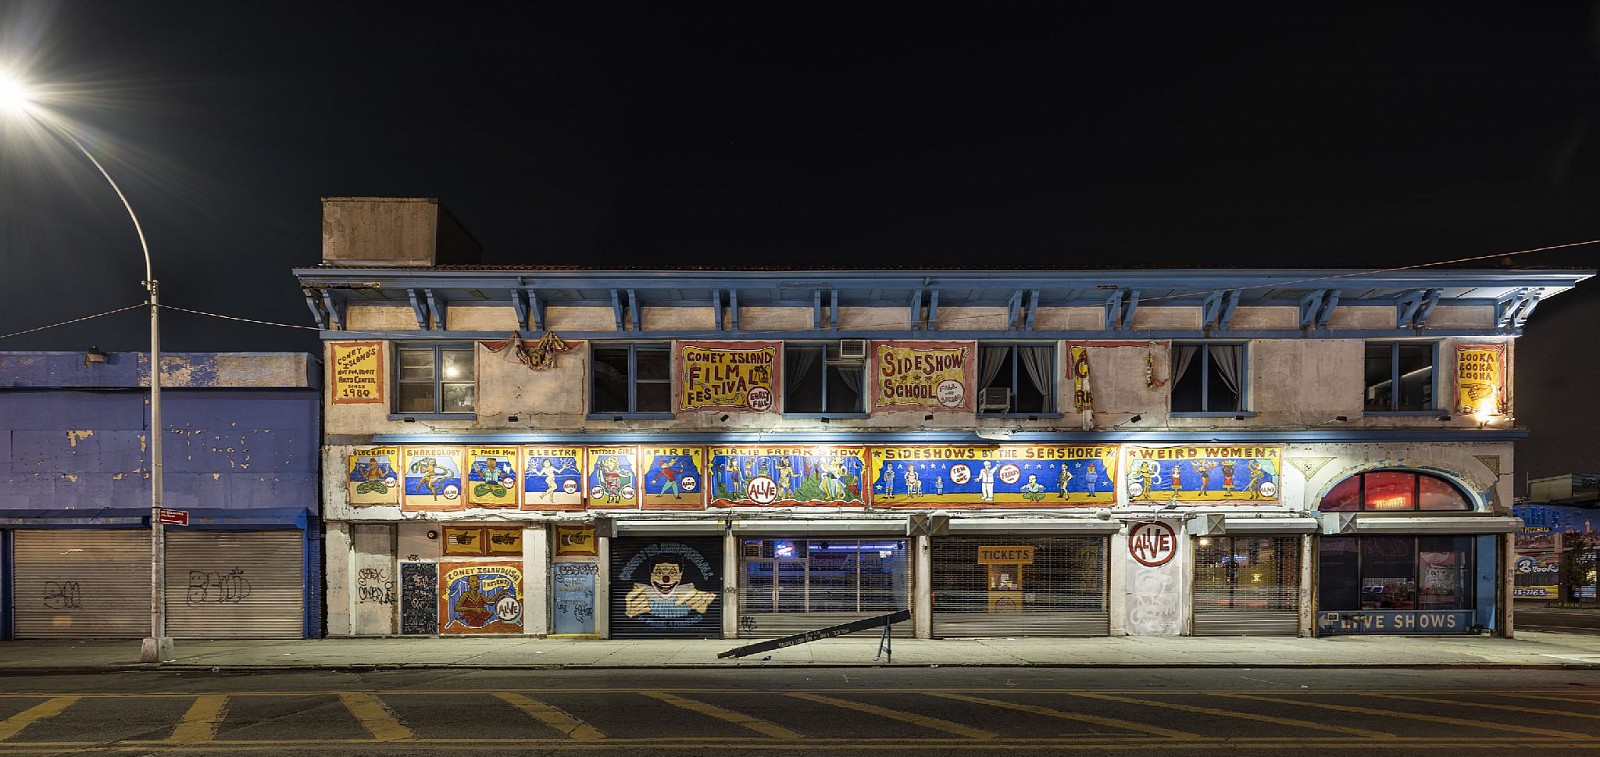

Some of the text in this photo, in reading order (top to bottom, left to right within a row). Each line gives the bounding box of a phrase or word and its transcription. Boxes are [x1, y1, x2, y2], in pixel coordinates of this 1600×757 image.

[338, 348, 361, 365] CONEY
[343, 348, 376, 369] ISLAND'S
[687, 352, 773, 364] CONEY ISLAND
[1460, 353, 1494, 362] LOOKA
[882, 349, 965, 377] SIDESHOW
[1459, 362, 1493, 371] LOOKA
[354, 376, 376, 384] CENTER
[689, 364, 740, 390] FILM
[1459, 371, 1492, 380] LOOKA
[687, 369, 758, 405] FESTIVAL
[883, 379, 937, 399] SCHOOL
[343, 389, 370, 397] 1980
[749, 391, 770, 402] EARLY
[752, 400, 769, 408] FALL
[654, 448, 690, 456] FIRE
[885, 448, 1102, 459] SIDESHOWS BY THE SEASHORE
[1139, 448, 1266, 459] WEIRD WOMEN
[749, 479, 776, 500] ALIVE
[1134, 527, 1170, 559] ALIVE
[982, 550, 1030, 560] TICKETS
[448, 568, 475, 580] CONEY
[483, 579, 510, 588] PRESENTS
[499, 601, 518, 617] ALIVE
[1394, 614, 1456, 628] SHOWS
